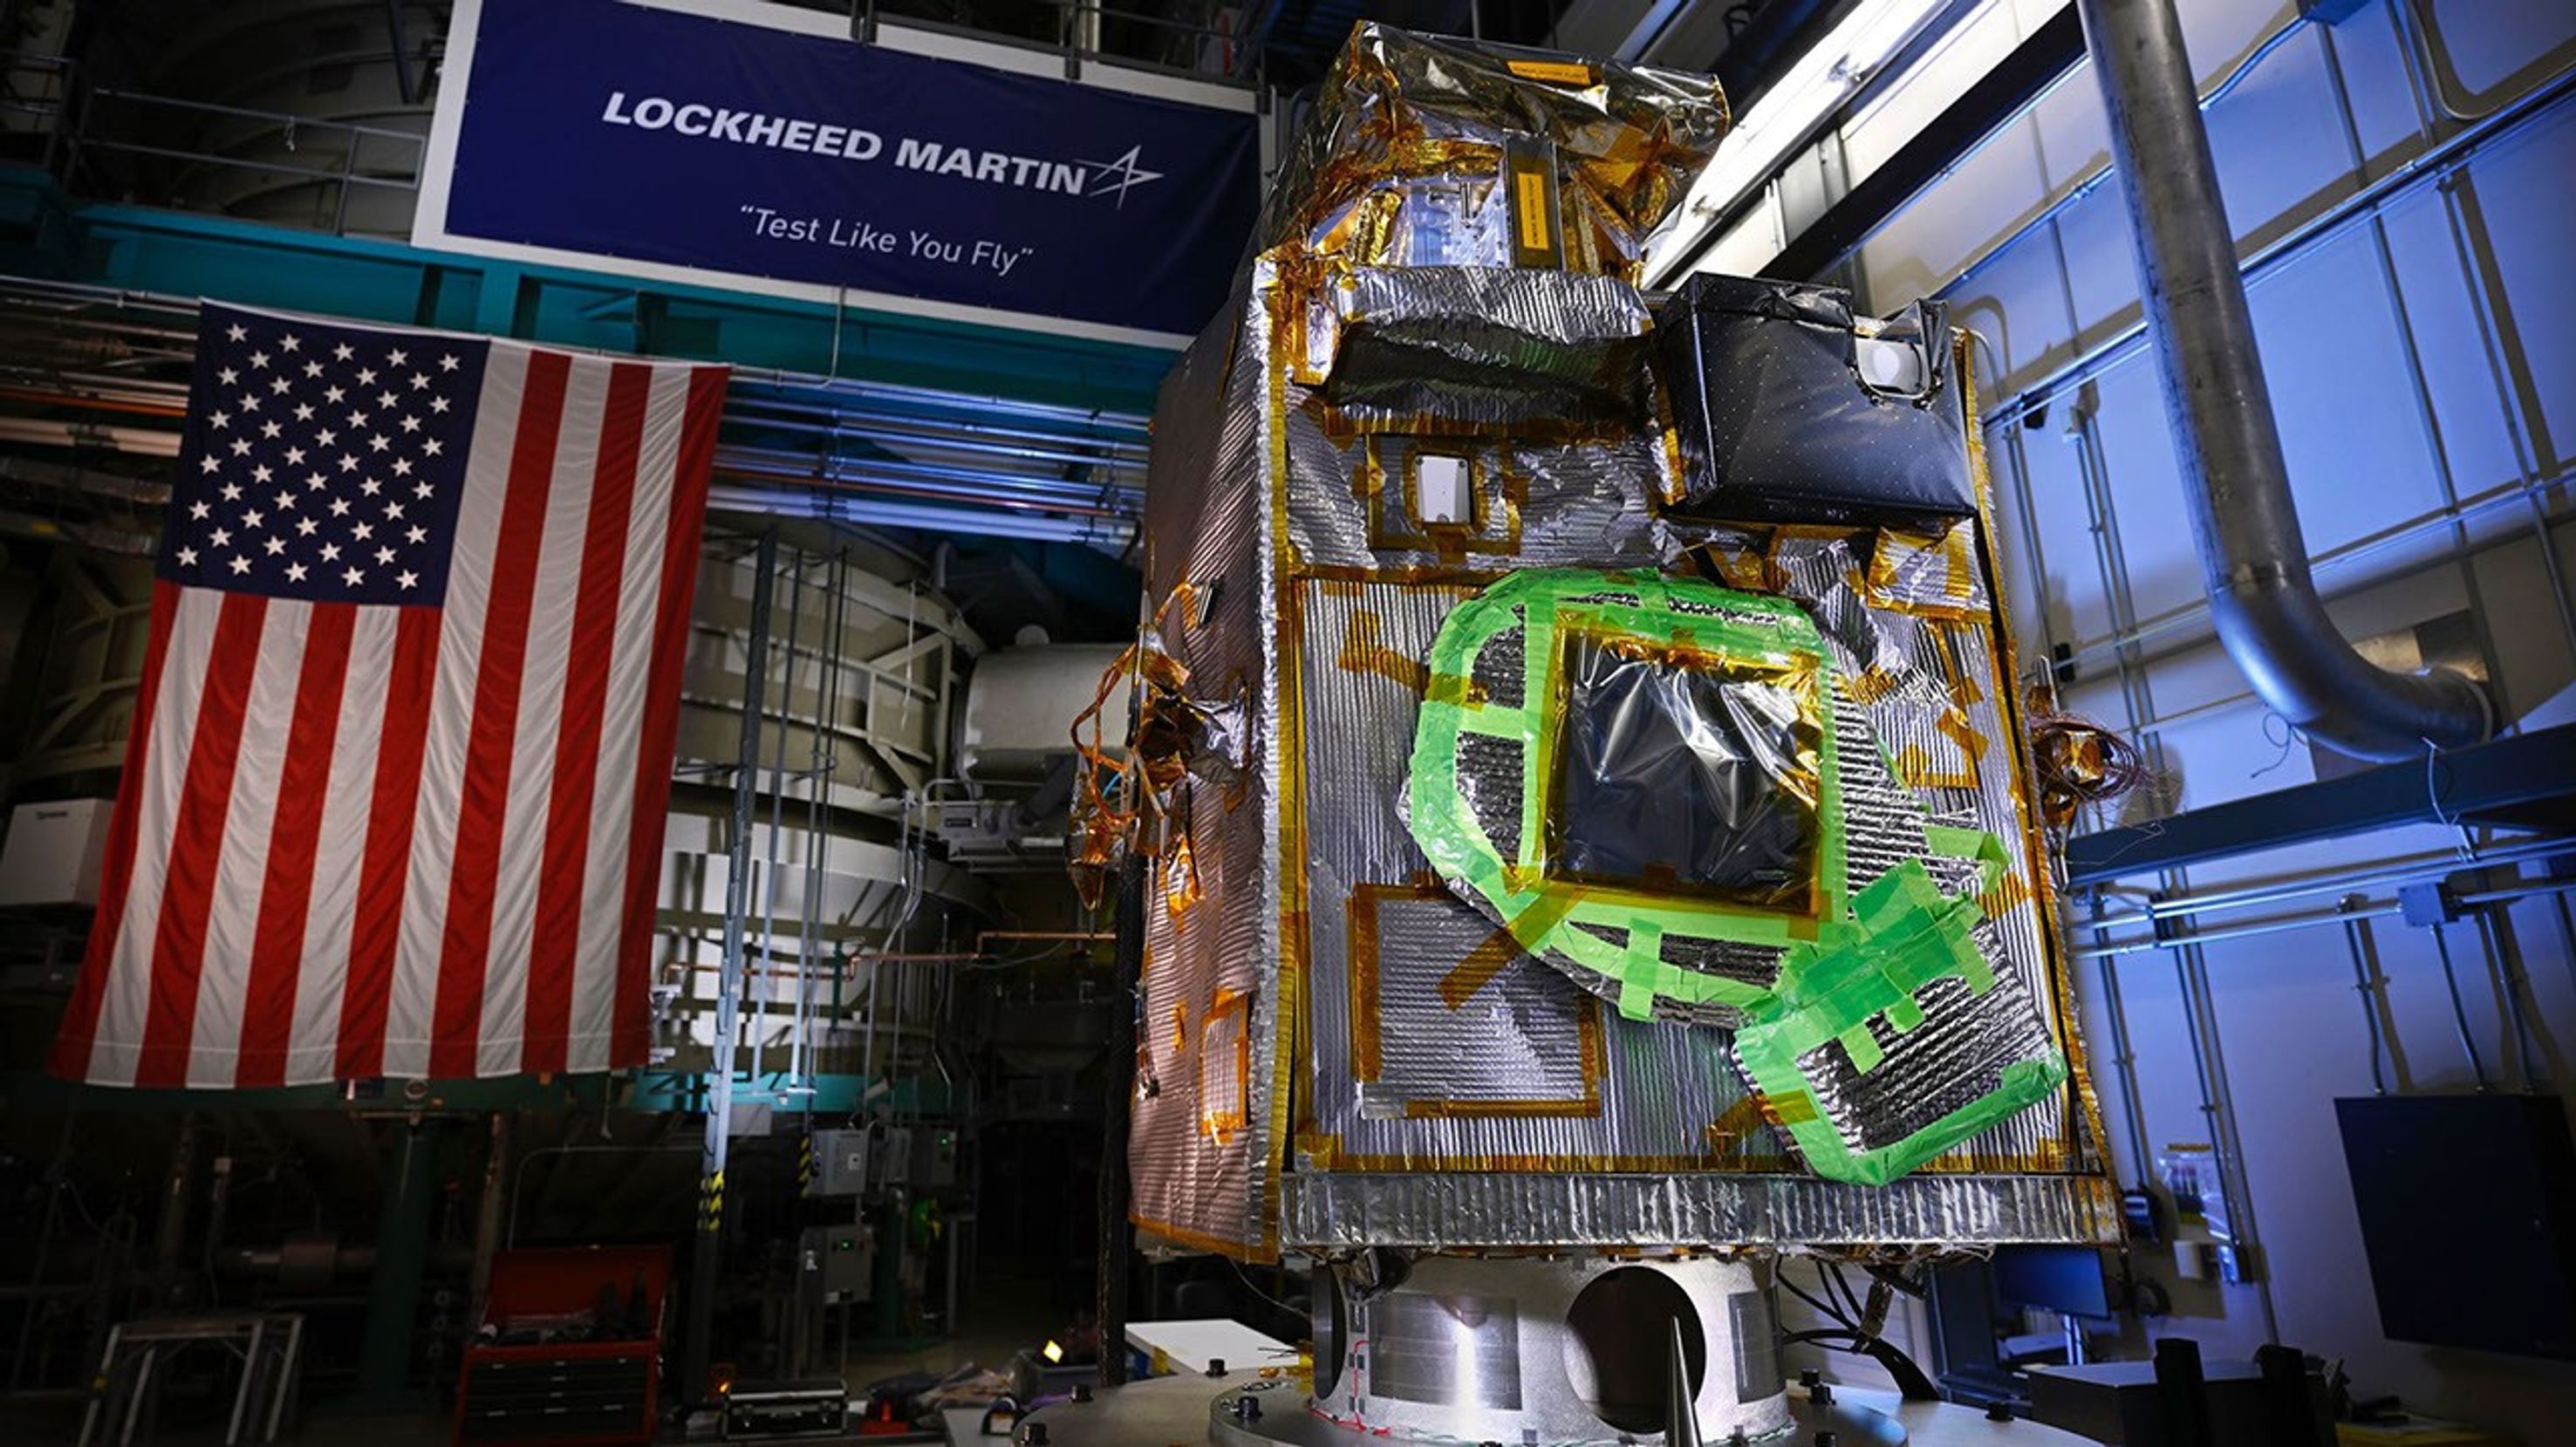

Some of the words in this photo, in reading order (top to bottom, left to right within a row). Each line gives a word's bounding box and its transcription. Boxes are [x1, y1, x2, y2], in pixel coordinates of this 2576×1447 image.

[602, 92, 883, 160] LOCKHEED
[894, 138, 1087, 195] MARTIN
[829, 219, 897, 253] Like
[909, 230, 961, 263] You
